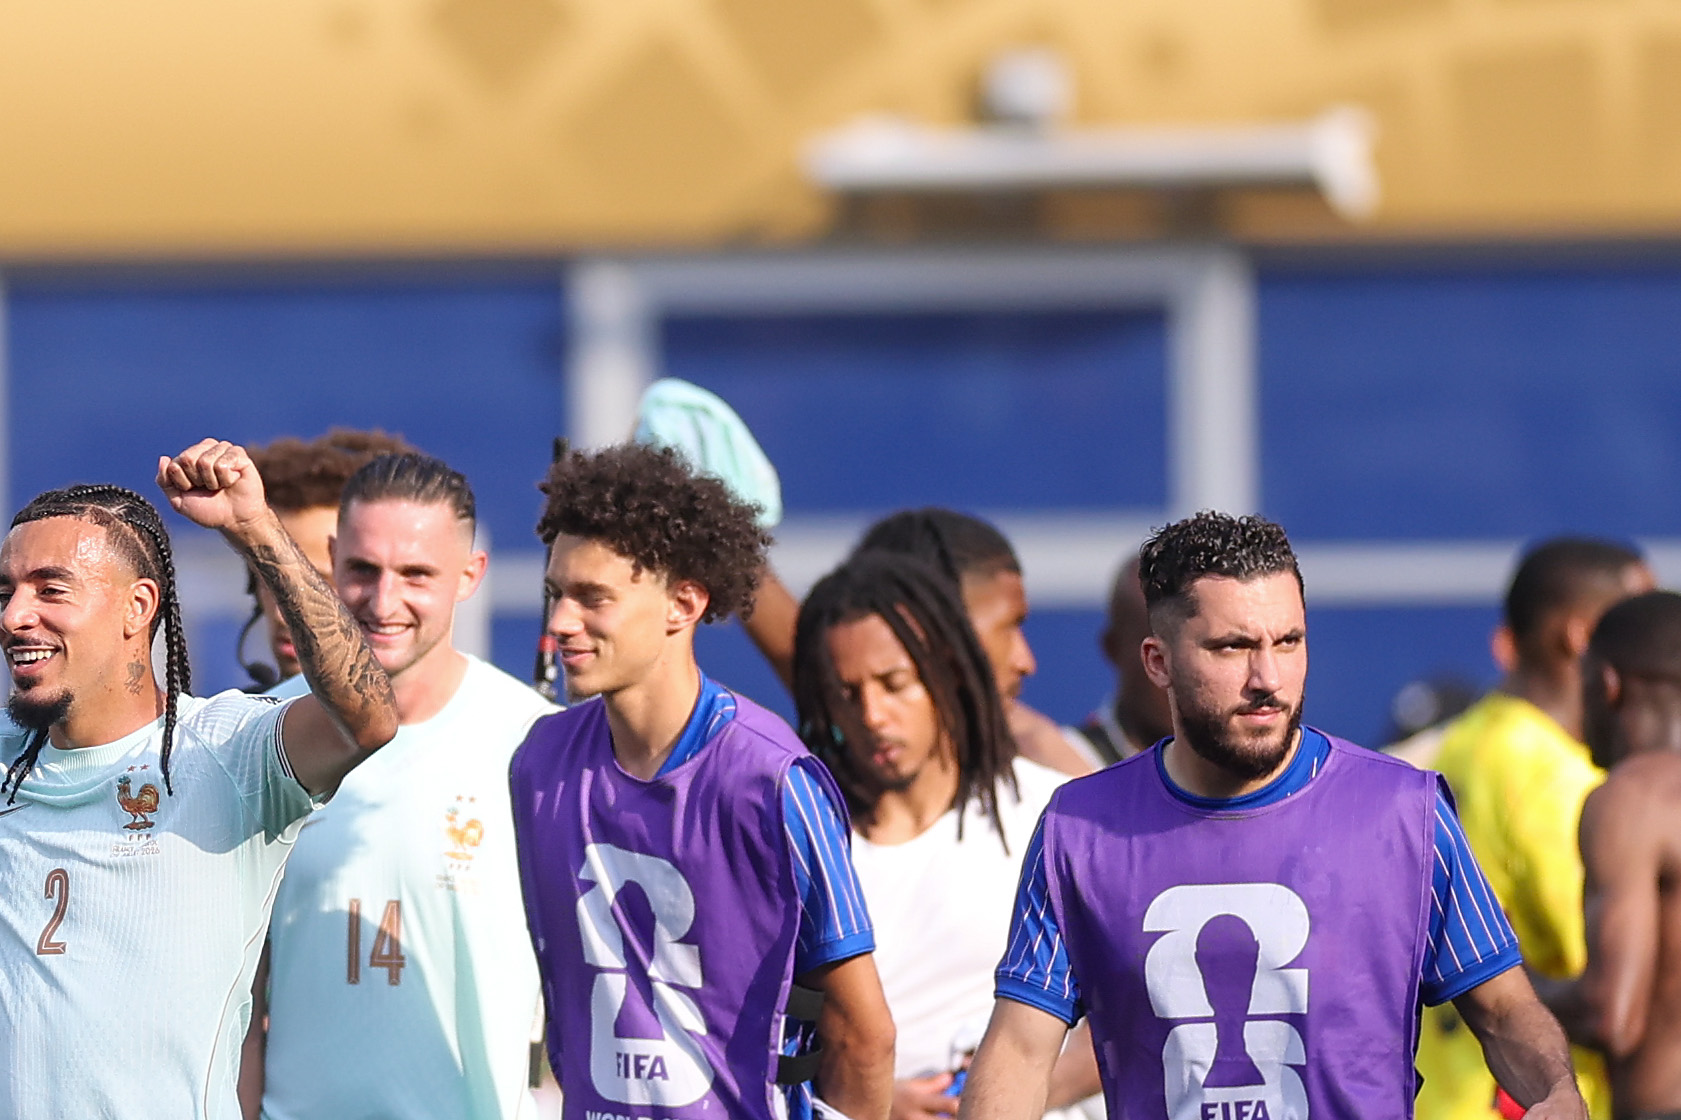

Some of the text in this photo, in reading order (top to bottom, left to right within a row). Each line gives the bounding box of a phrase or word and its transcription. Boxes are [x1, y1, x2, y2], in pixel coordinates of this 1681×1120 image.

[36, 867, 70, 956] 2
[347, 898, 407, 987] 14
[616, 1052, 670, 1081] FIFA
